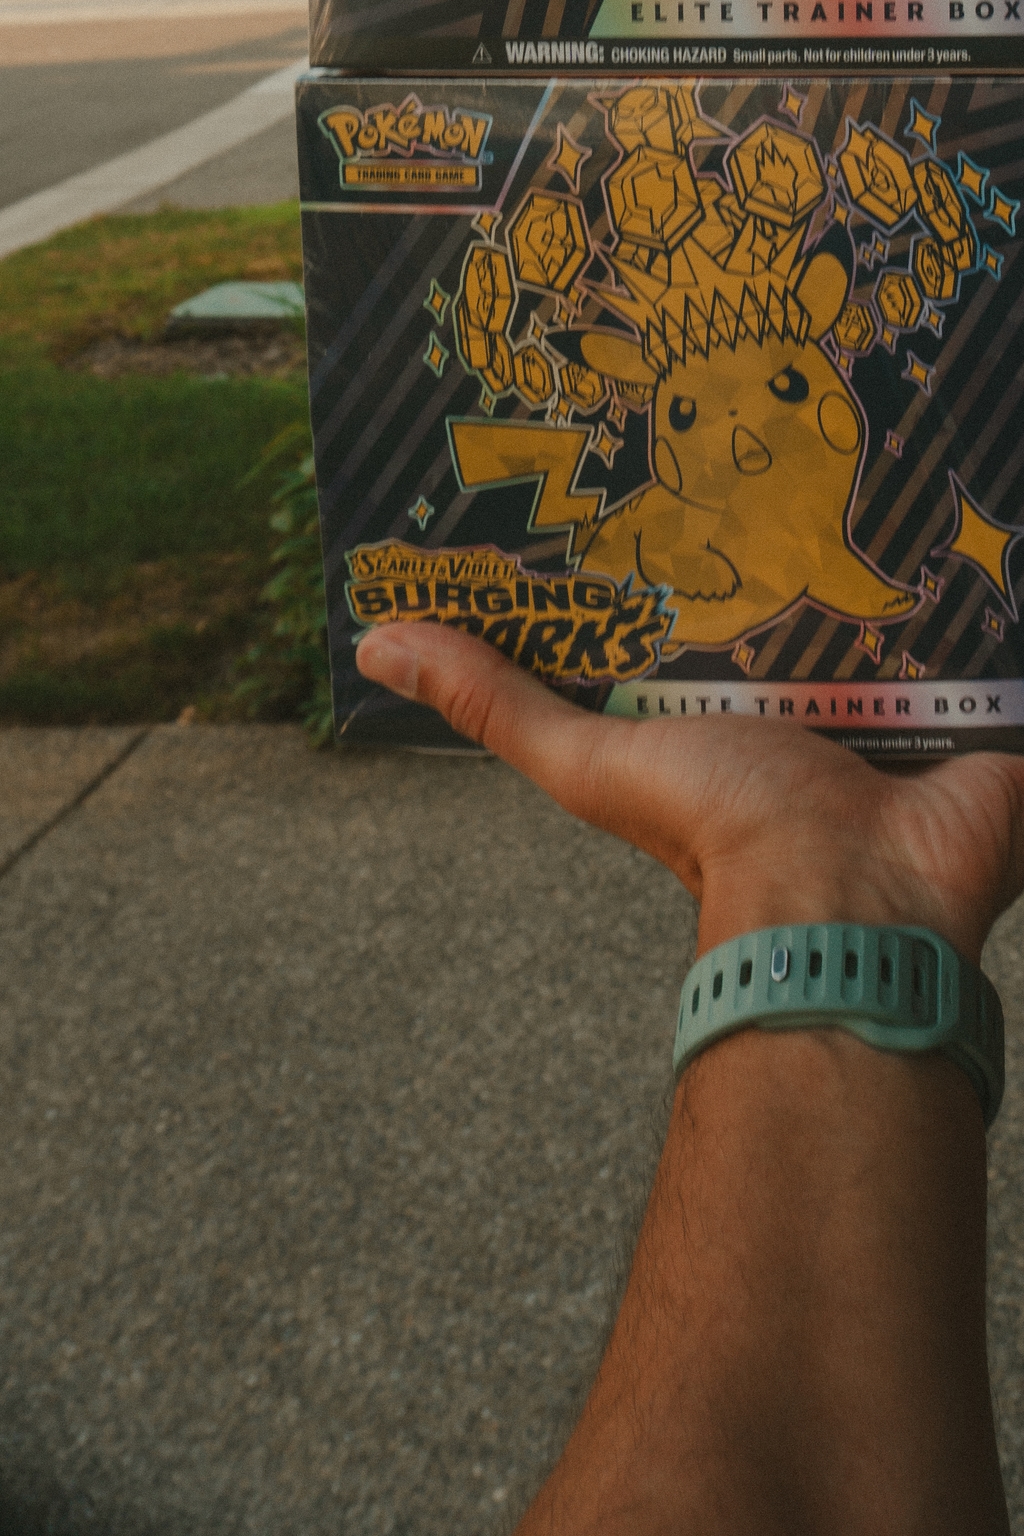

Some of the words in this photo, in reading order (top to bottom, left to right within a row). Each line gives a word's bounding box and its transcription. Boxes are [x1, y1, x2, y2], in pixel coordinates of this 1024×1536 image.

[631, 0, 734, 23] ELITE
[757, 0, 924, 22] TRAINER
[505, 41, 605, 64] WARNING:
[611, 46, 670, 64] CHOKING
[673, 46, 727, 64] HAZARD
[733, 47, 766, 64] Small
[767, 48, 801, 66] parts.
[803, 47, 824, 63] Not
[825, 47, 842, 63] for
[843, 47, 890, 63] children
[892, 47, 926, 63] under
[927, 47, 935, 63] 3
[936, 47, 972, 65] years.
[357, 169, 400, 180] TRADING
[404, 170, 432, 181] CARD
[435, 170, 465, 181] GAME
[353, 577, 616, 615] SURGING
[635, 695, 732, 715] ELITE
[754, 695, 911, 716] TRAINER
[933, 694, 1002, 715] BOX
